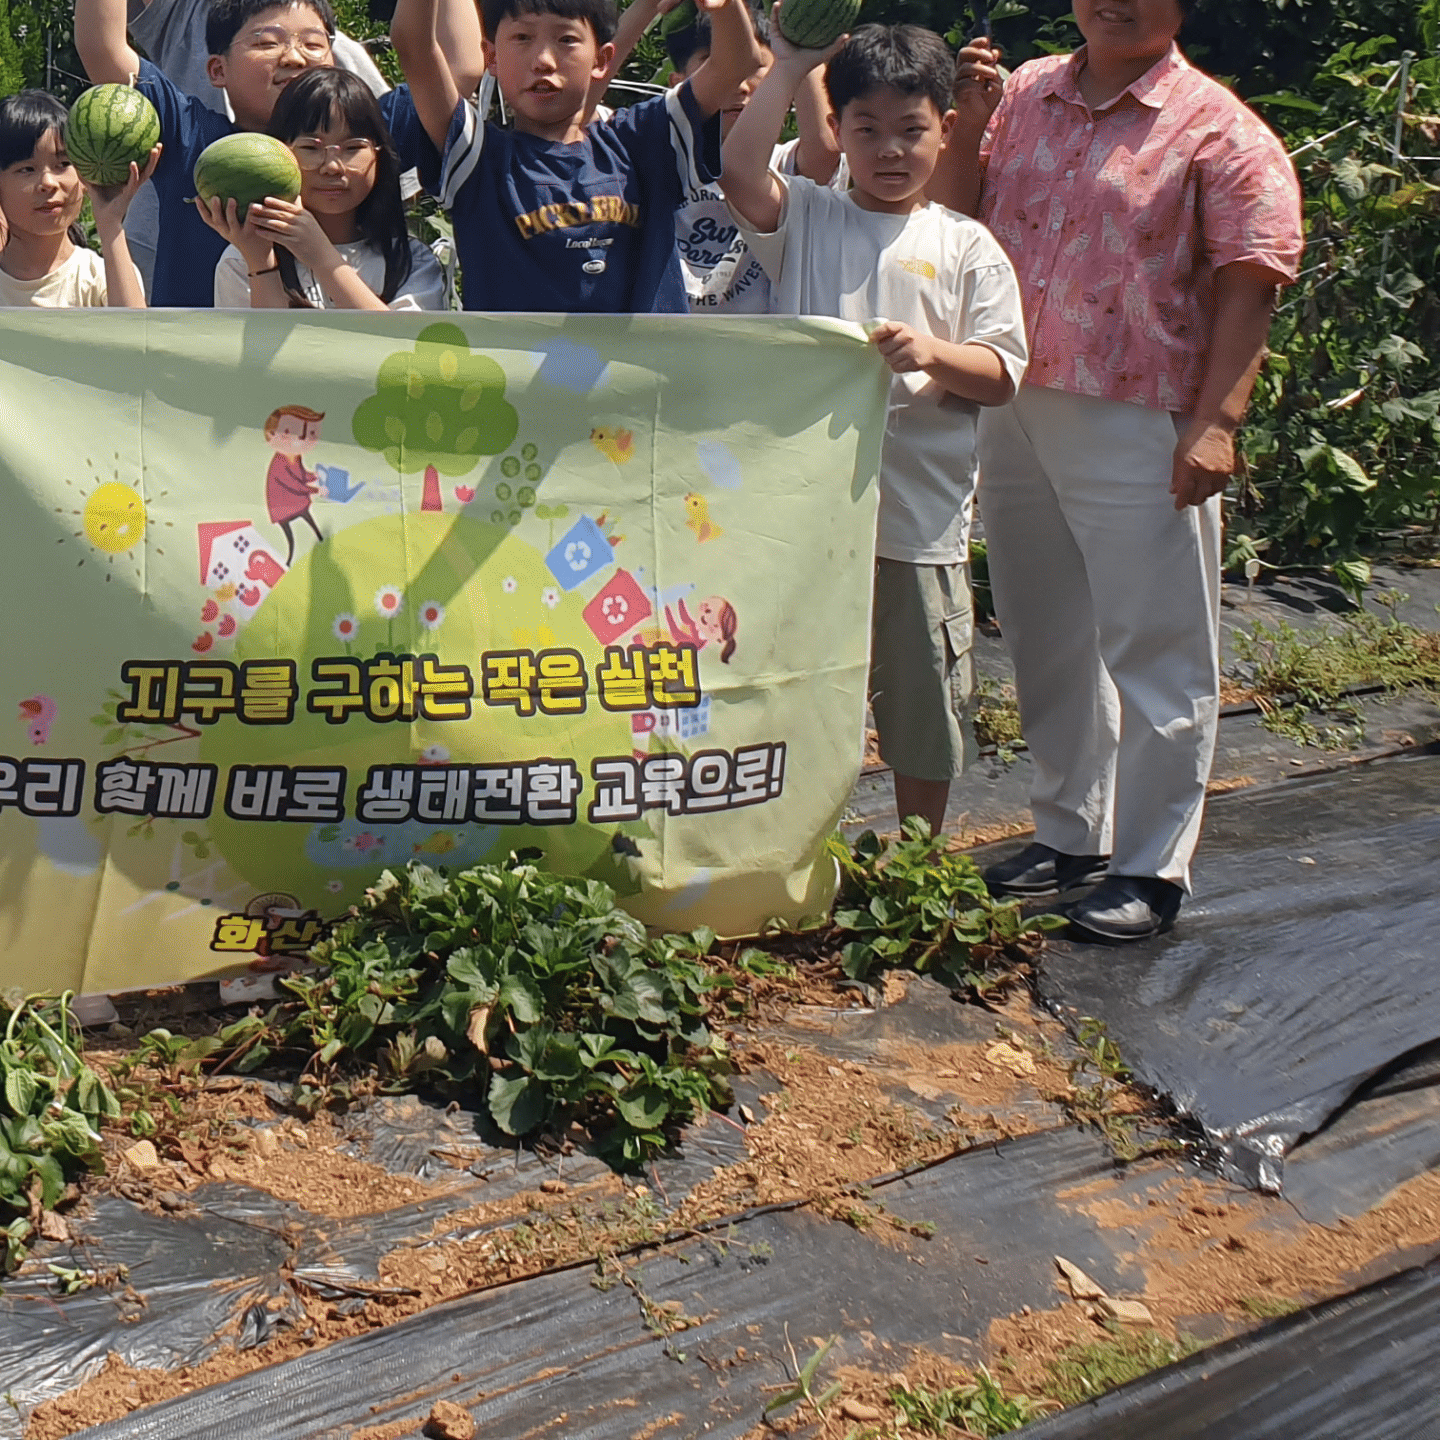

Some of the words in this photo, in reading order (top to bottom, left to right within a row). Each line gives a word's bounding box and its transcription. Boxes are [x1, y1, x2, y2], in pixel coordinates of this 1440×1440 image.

[721, 260, 763, 302] WAVES
[118, 658, 298, 726] 지구를
[307, 654, 472, 727] 구하는
[483, 648, 589, 716] 작은
[594, 642, 702, 712] 실천
[94, 760, 218, 821] 함께
[225, 763, 346, 822] 바로
[354, 758, 582, 825] 생태전환
[586, 741, 789, 824] 교육으로!
